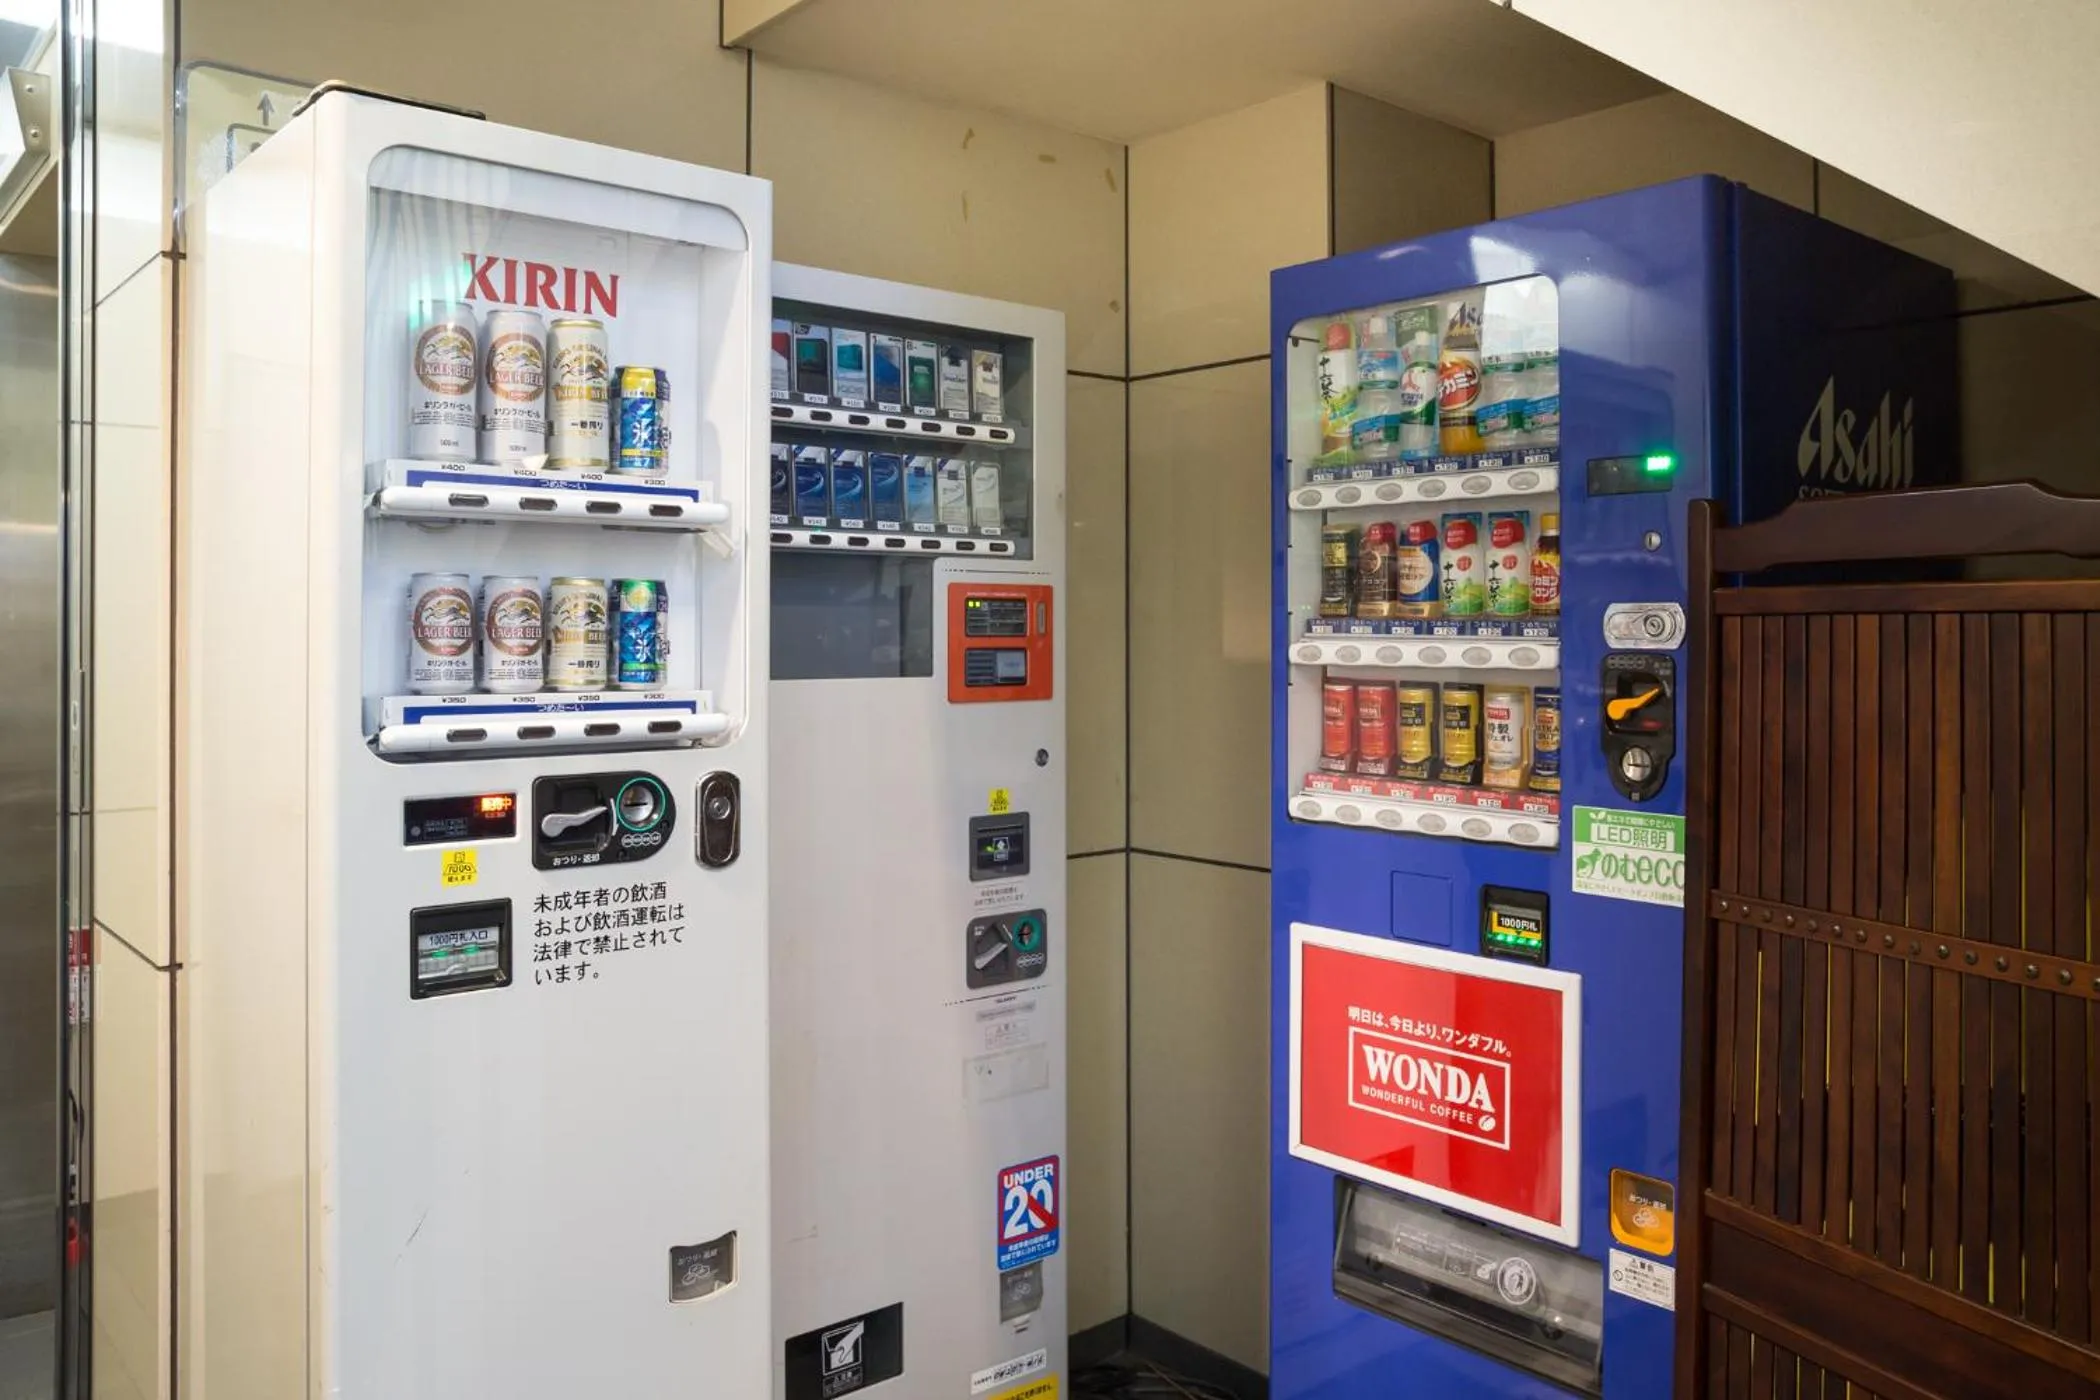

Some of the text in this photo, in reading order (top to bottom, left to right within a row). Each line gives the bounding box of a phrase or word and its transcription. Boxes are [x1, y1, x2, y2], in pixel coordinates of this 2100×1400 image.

[463, 252, 620, 318] KIRIN
[1797, 374, 1914, 489] Asahi
[1597, 825, 1667, 849] LED照明
[533, 881, 667, 913] 未成年者の飲酒
[534, 903, 684, 938] および飲酒運転は
[533, 926, 685, 962] 法律で禁止されて
[535, 960, 600, 985] います。
[1348, 1006, 1512, 1058] 明日は、今日より、ワンダフル。
[1362, 1045, 1496, 1113] WONDA
[1361, 1085, 1474, 1125] WONDERFUL COFFEE
[1003, 1163, 1054, 1189] UNDER
[1004, 1179, 1054, 1239] 20
